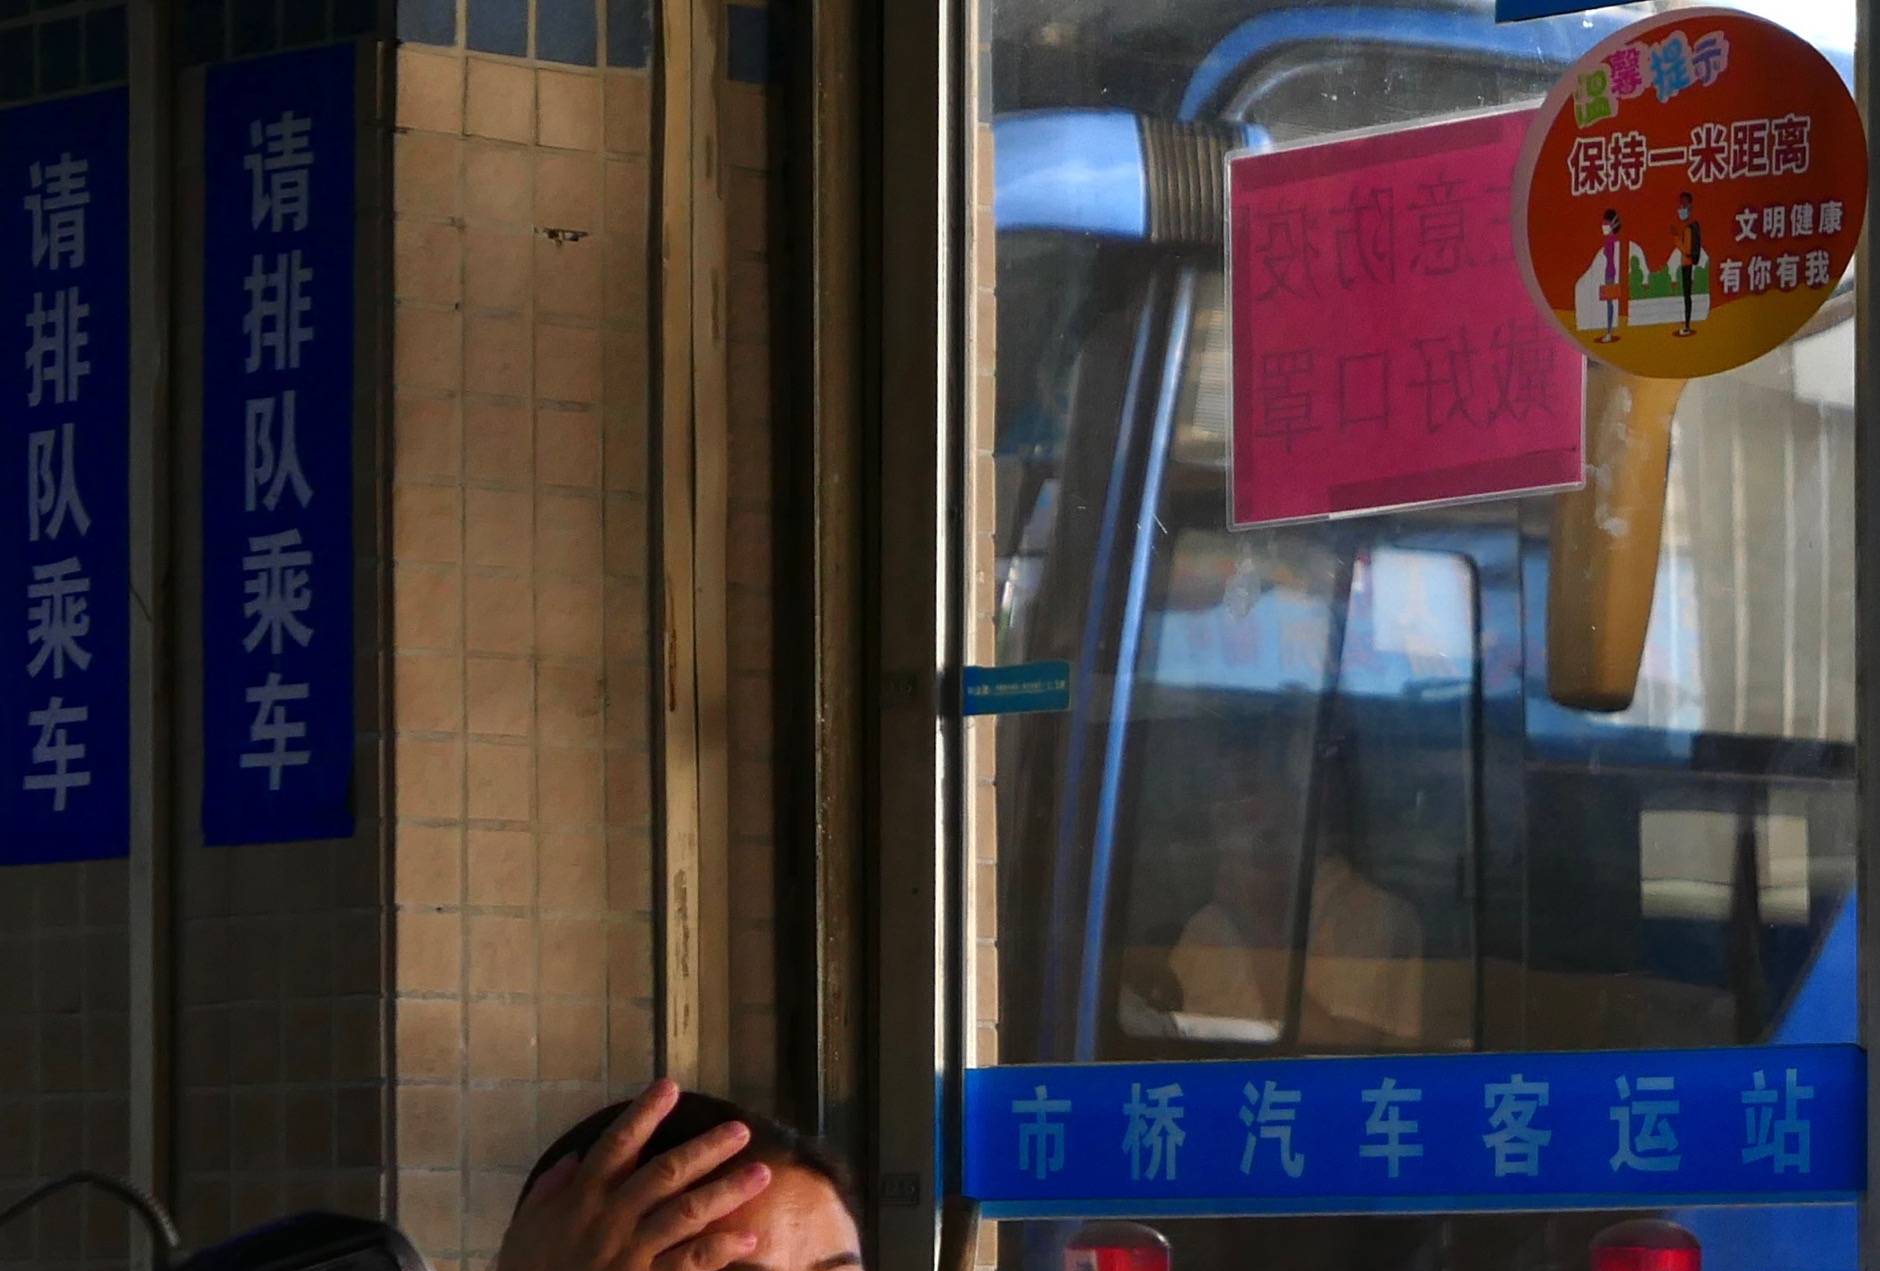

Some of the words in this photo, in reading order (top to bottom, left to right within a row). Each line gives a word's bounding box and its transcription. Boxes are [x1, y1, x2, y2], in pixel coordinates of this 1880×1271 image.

[1575, 35, 1726, 126] 温馨提示
[1568, 114, 1811, 196] 保持一米距离
[1735, 201, 1843, 241] 文明健康
[1720, 250, 1830, 294] 有你有我
[23, 152, 92, 812] 请排队乘车
[239, 110, 315, 791] 请排队乘车
[1011, 1068, 1815, 1180] 市桥汽车客运站
